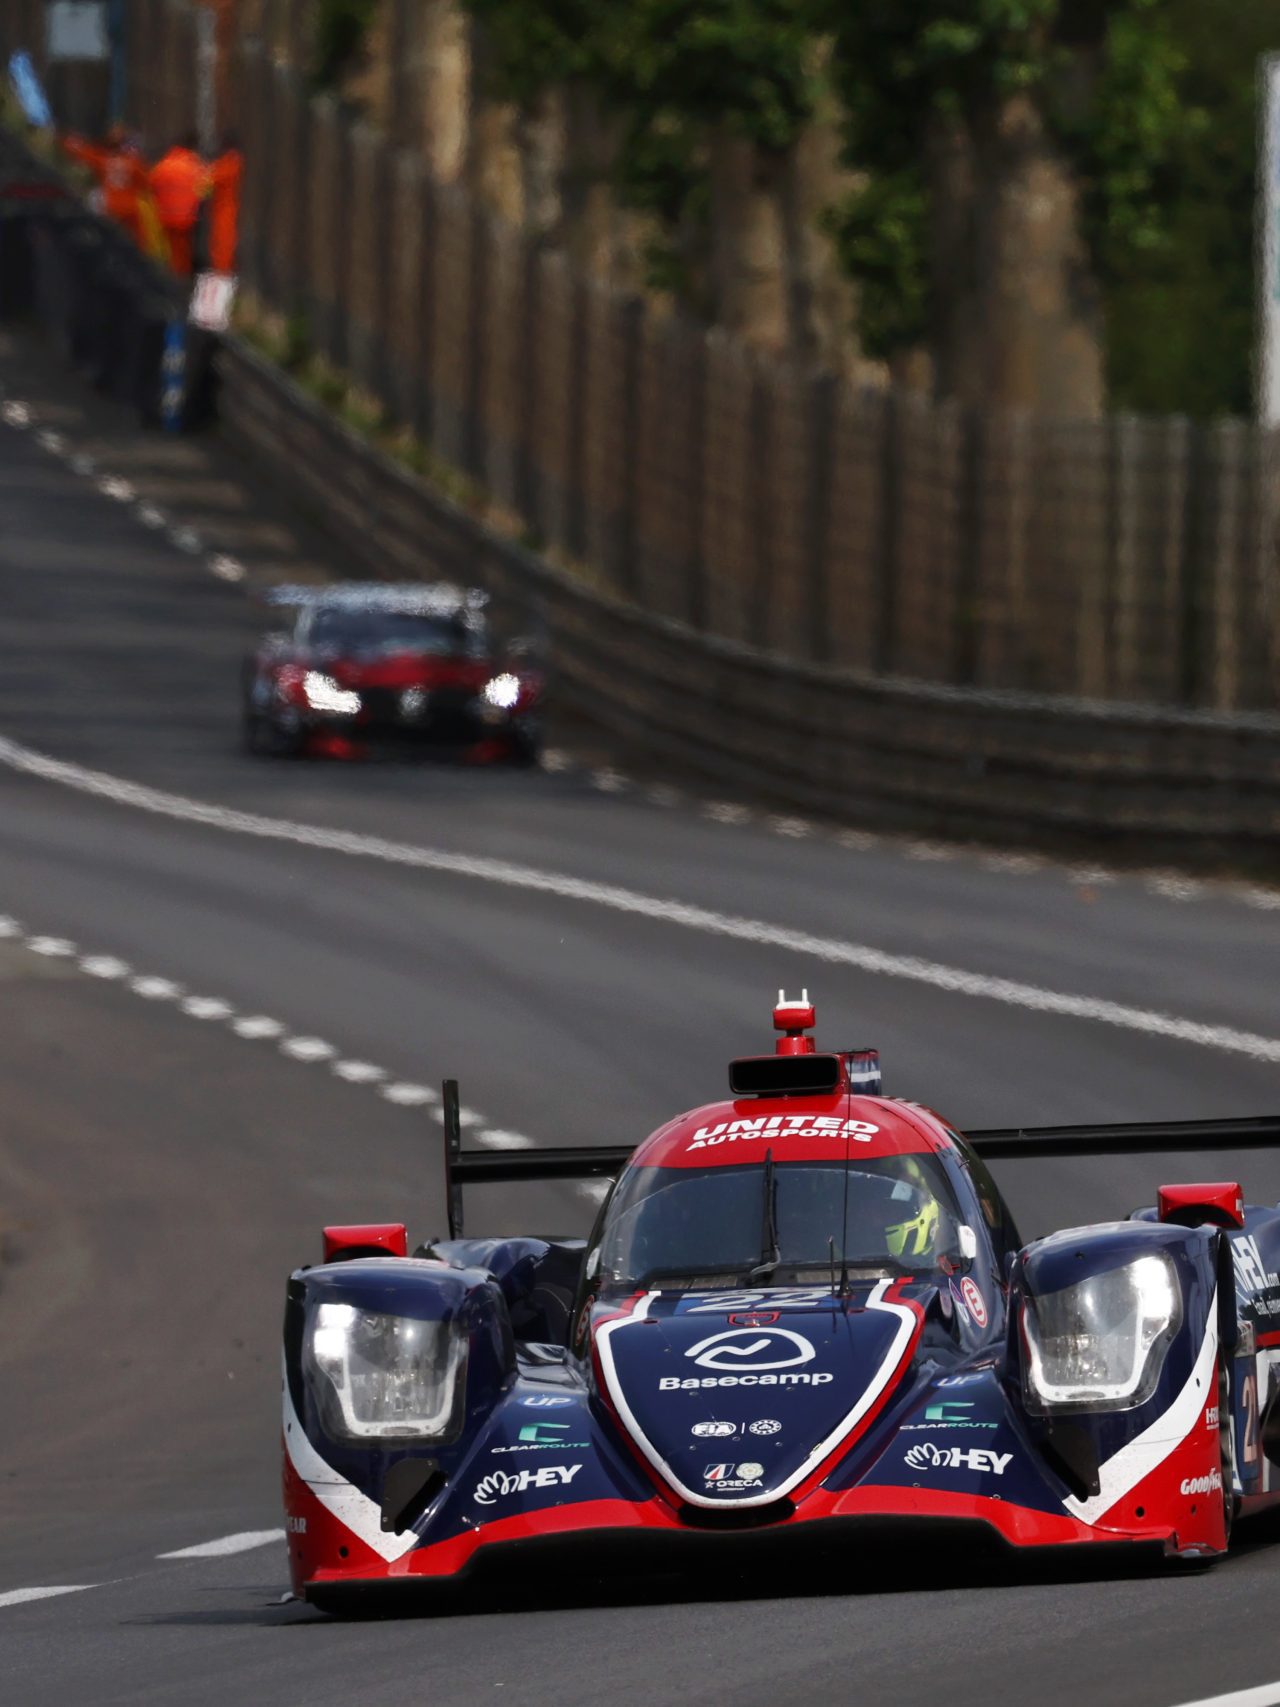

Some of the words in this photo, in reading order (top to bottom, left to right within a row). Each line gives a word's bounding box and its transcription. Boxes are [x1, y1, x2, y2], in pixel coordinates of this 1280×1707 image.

[693, 1115, 880, 1141] UNITED
[685, 1128, 873, 1152] AUTOSPORTS
[658, 1372, 834, 1391] Basecamp
[937, 1374, 985, 1387] UP
[523, 1397, 573, 1407] UP
[692, 1422, 735, 1437] FIA
[949, 1447, 1014, 1475] HEY
[517, 1463, 584, 1492] HEY
[716, 1479, 764, 1489] ORECA
